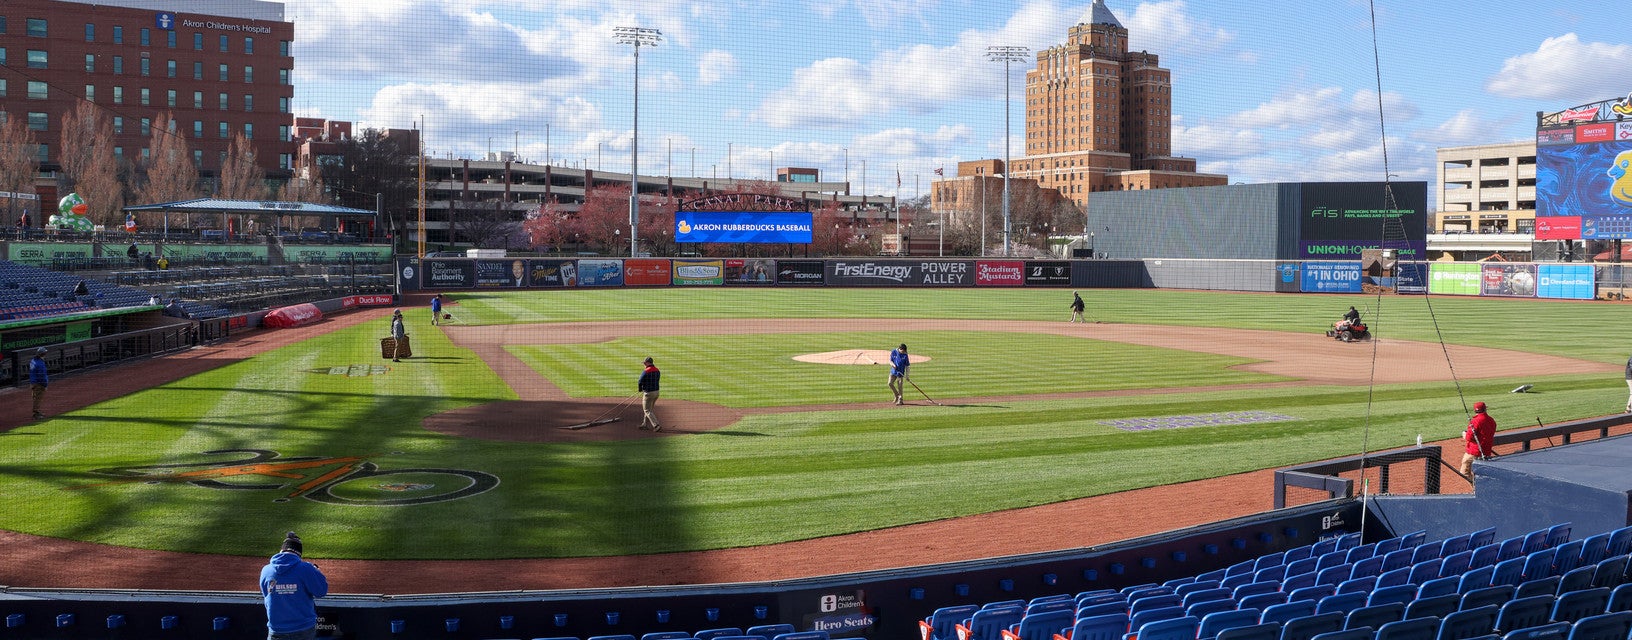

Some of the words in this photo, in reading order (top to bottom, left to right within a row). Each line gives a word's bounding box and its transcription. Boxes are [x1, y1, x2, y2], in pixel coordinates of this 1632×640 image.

[182, 20, 204, 28] Akron
[206, 22, 240, 31] Children's
[242, 25, 271, 34] Hospital
[694, 195, 740, 210] CANAL
[754, 194, 793, 210] PARK
[835, 263, 912, 278] FirstEnergy
[921, 263, 966, 273] POWER
[979, 264, 1020, 273] Stadium
[531, 268, 557, 280] Miller
[923, 274, 964, 284] ALLEY
[1308, 270, 1318, 280] #1
[1320, 270, 1330, 280] IN
[1333, 270, 1359, 280] OHIO
[1443, 272, 1479, 281] Huntington
[814, 621, 841, 630] Hero
[844, 616, 873, 627] Seats
